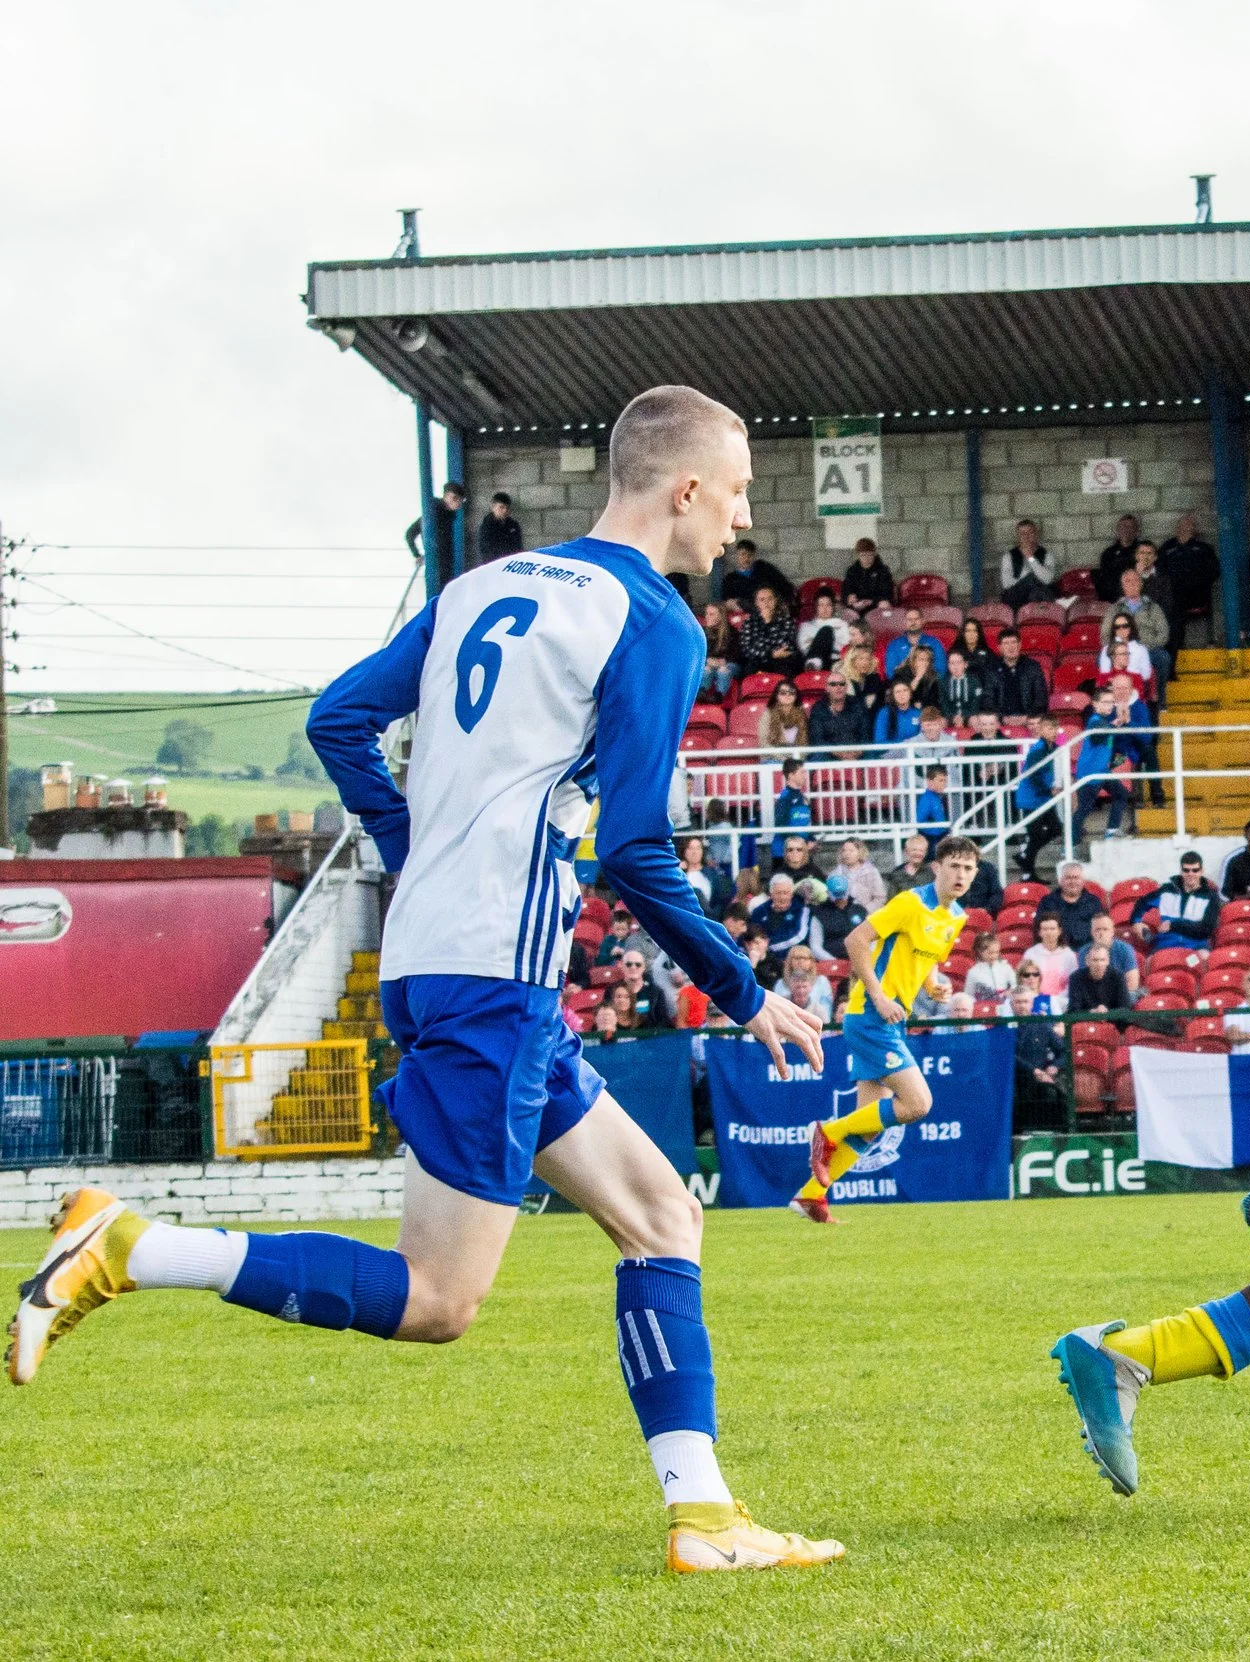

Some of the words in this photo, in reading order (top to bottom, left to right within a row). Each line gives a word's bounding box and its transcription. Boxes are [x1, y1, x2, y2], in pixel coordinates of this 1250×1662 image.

[820, 445, 876, 458] BLOCK
[819, 462, 870, 494] A1
[502, 560, 541, 576] HOME
[536, 565, 575, 582] FARM
[570, 575, 592, 588] FC
[454, 596, 539, 735] 6
[728, 1121, 811, 1145] FOUNDED
[920, 1121, 961, 1141] 1928
[832, 1178, 898, 1200] DUBLIN
